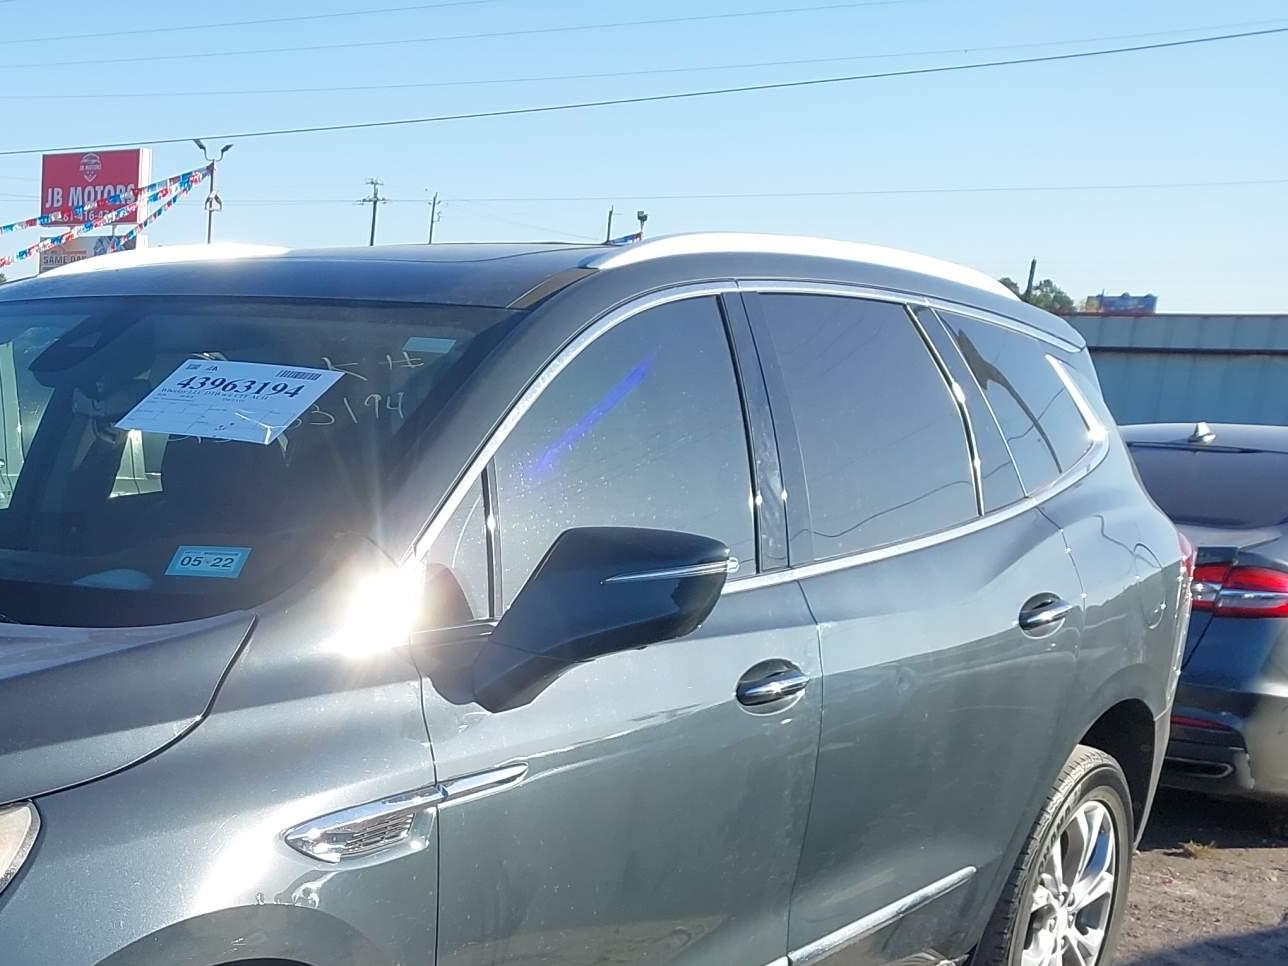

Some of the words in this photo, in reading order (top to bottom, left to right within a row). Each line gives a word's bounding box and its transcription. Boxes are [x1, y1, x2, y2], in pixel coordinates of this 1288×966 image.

[45, 187, 63, 208] JB
[43, 255, 68, 265] SAME
[176, 375, 305, 398] 43963194
